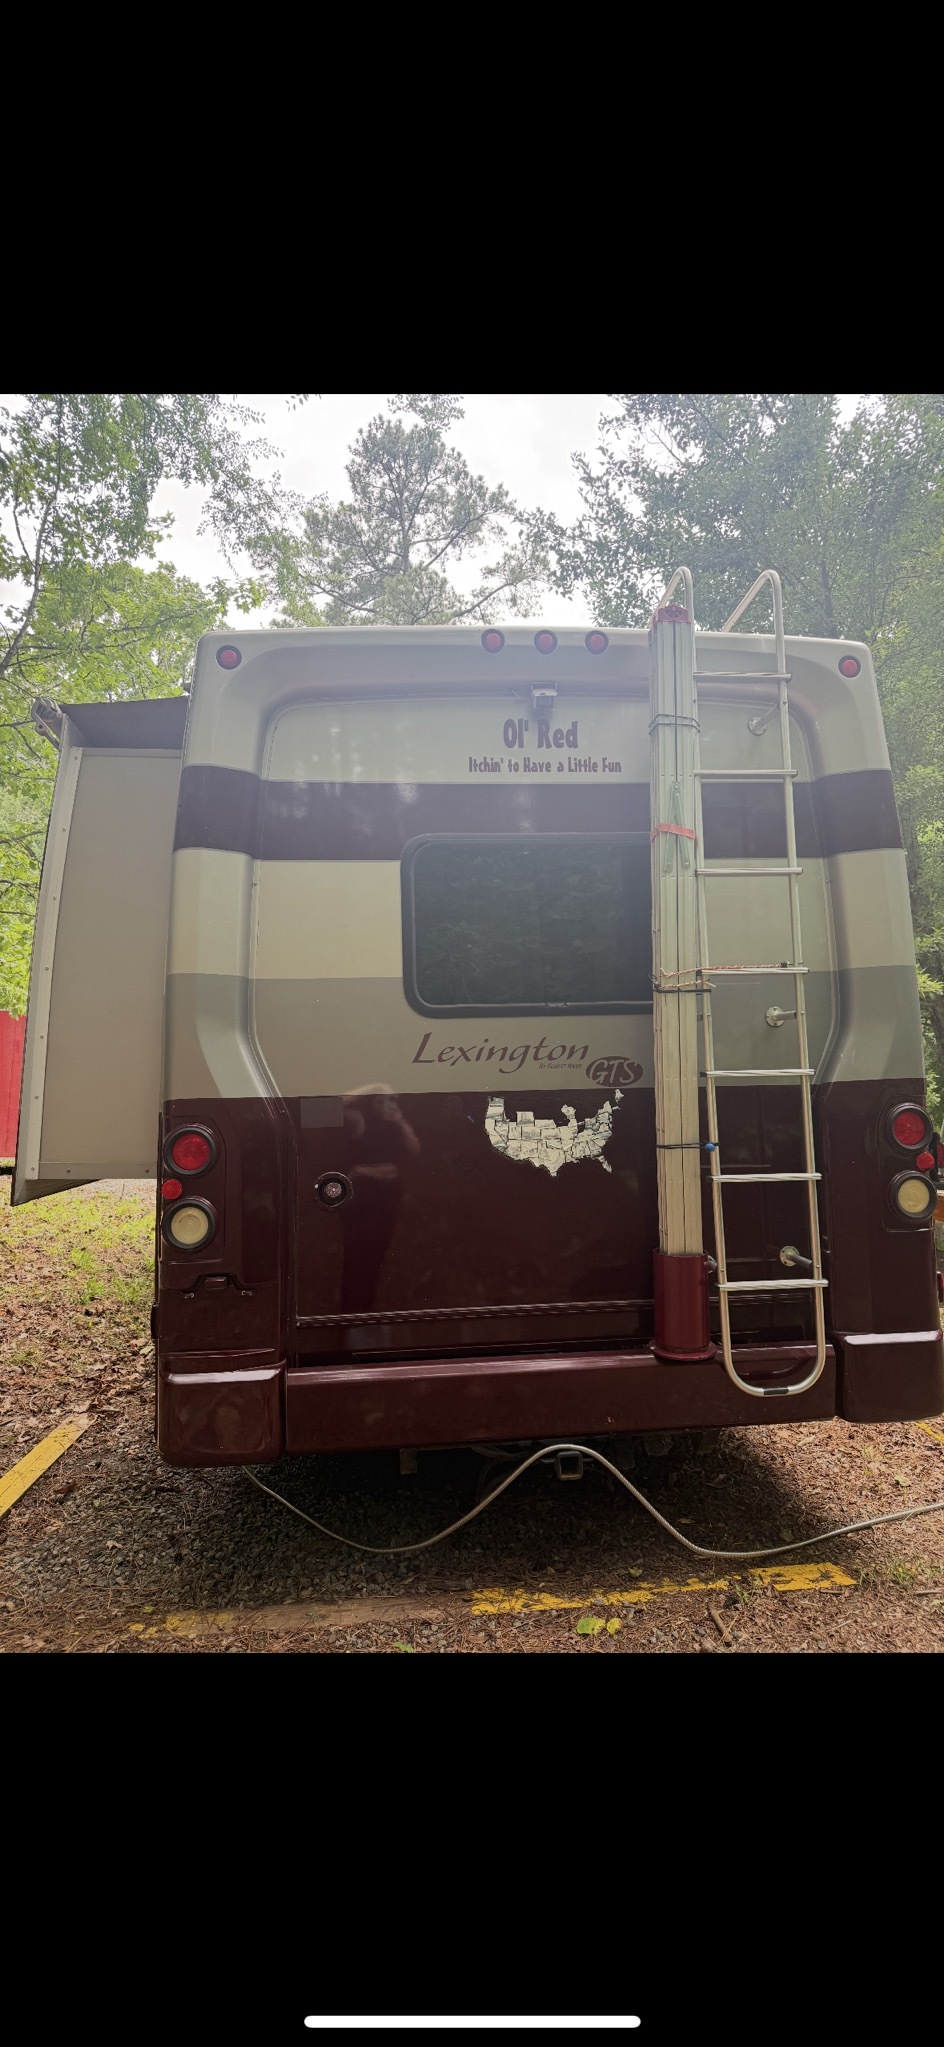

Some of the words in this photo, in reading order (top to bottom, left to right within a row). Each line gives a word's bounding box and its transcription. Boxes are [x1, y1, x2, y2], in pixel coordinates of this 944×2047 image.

[503, 718, 529, 749] Ol'
[537, 719, 579, 749] Red
[468, 756, 504, 773] Itchin'
[508, 757, 520, 773] to
[523, 757, 552, 773] Have
[557, 761, 564, 773] a
[568, 756, 598, 773] Little
[602, 757, 622, 773] Fun
[412, 1032, 589, 1074] Lexington
[589, 1059, 639, 1084] GTS
